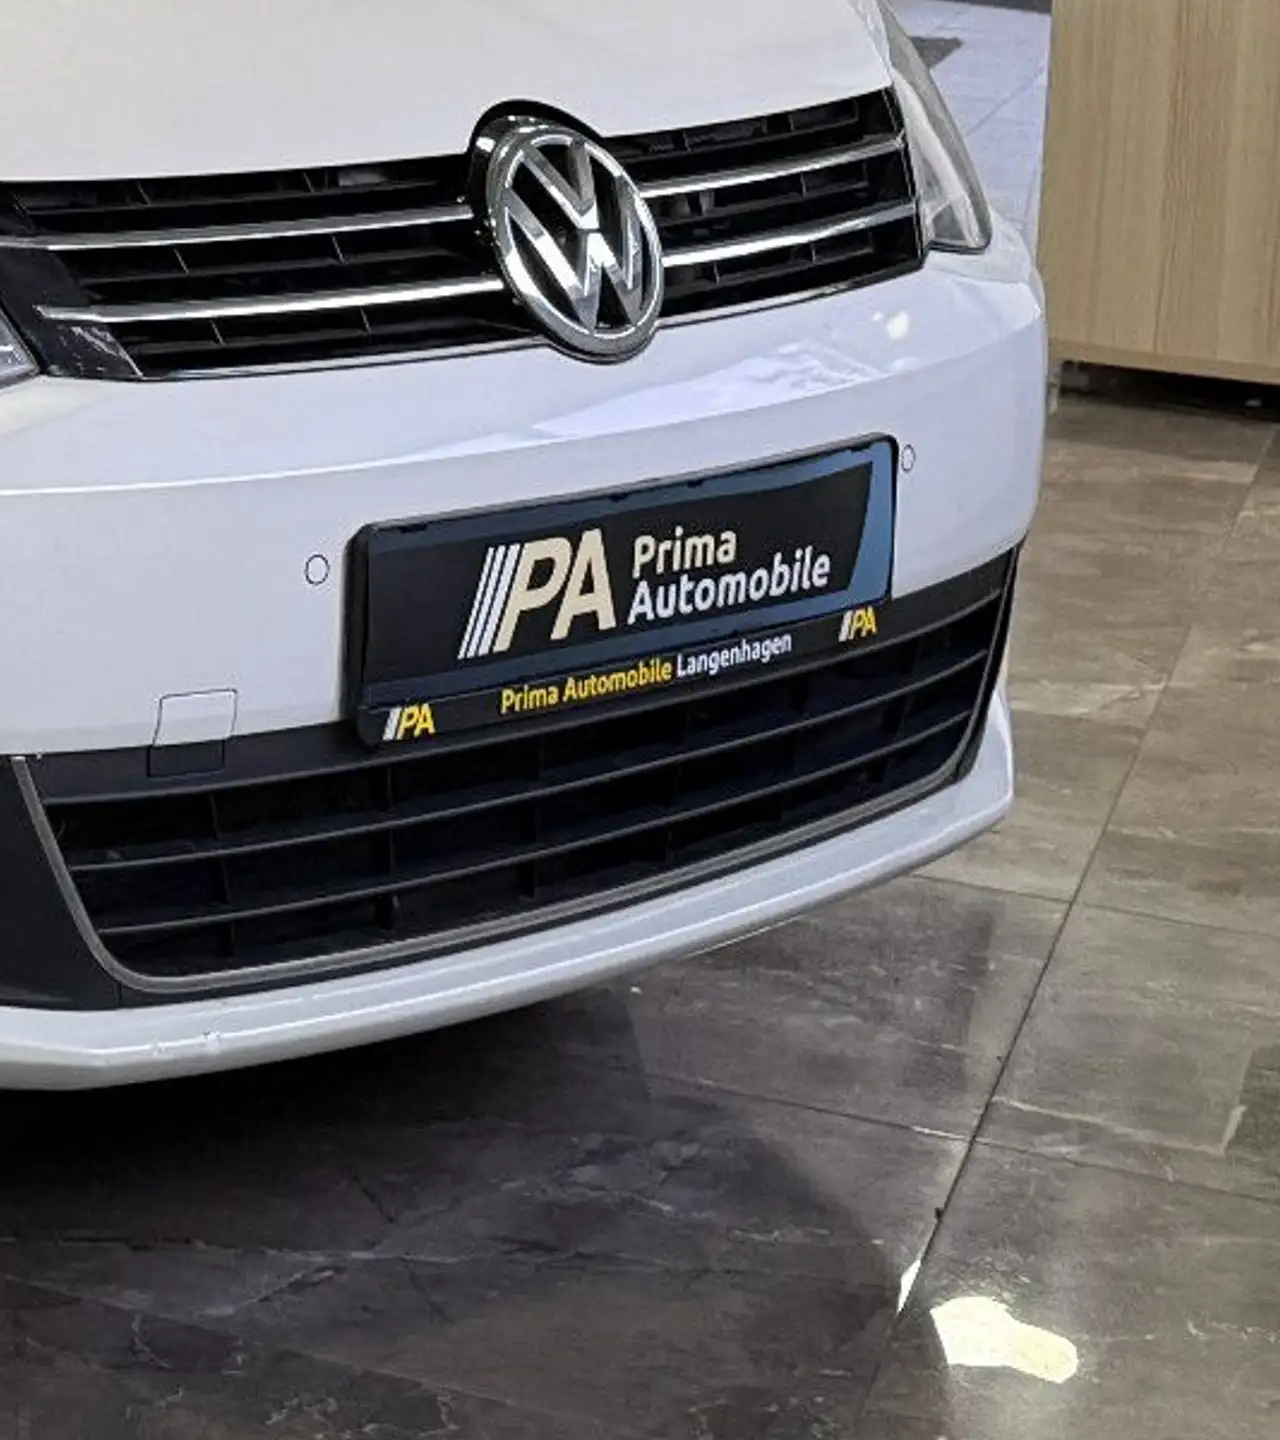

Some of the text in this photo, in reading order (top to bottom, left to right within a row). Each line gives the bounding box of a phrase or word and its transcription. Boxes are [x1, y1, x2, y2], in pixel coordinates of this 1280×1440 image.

[627, 544, 831, 626] Automobile
[632, 525, 737, 579] Prima
[500, 631, 793, 715] Prima Automobile Langenhagen
